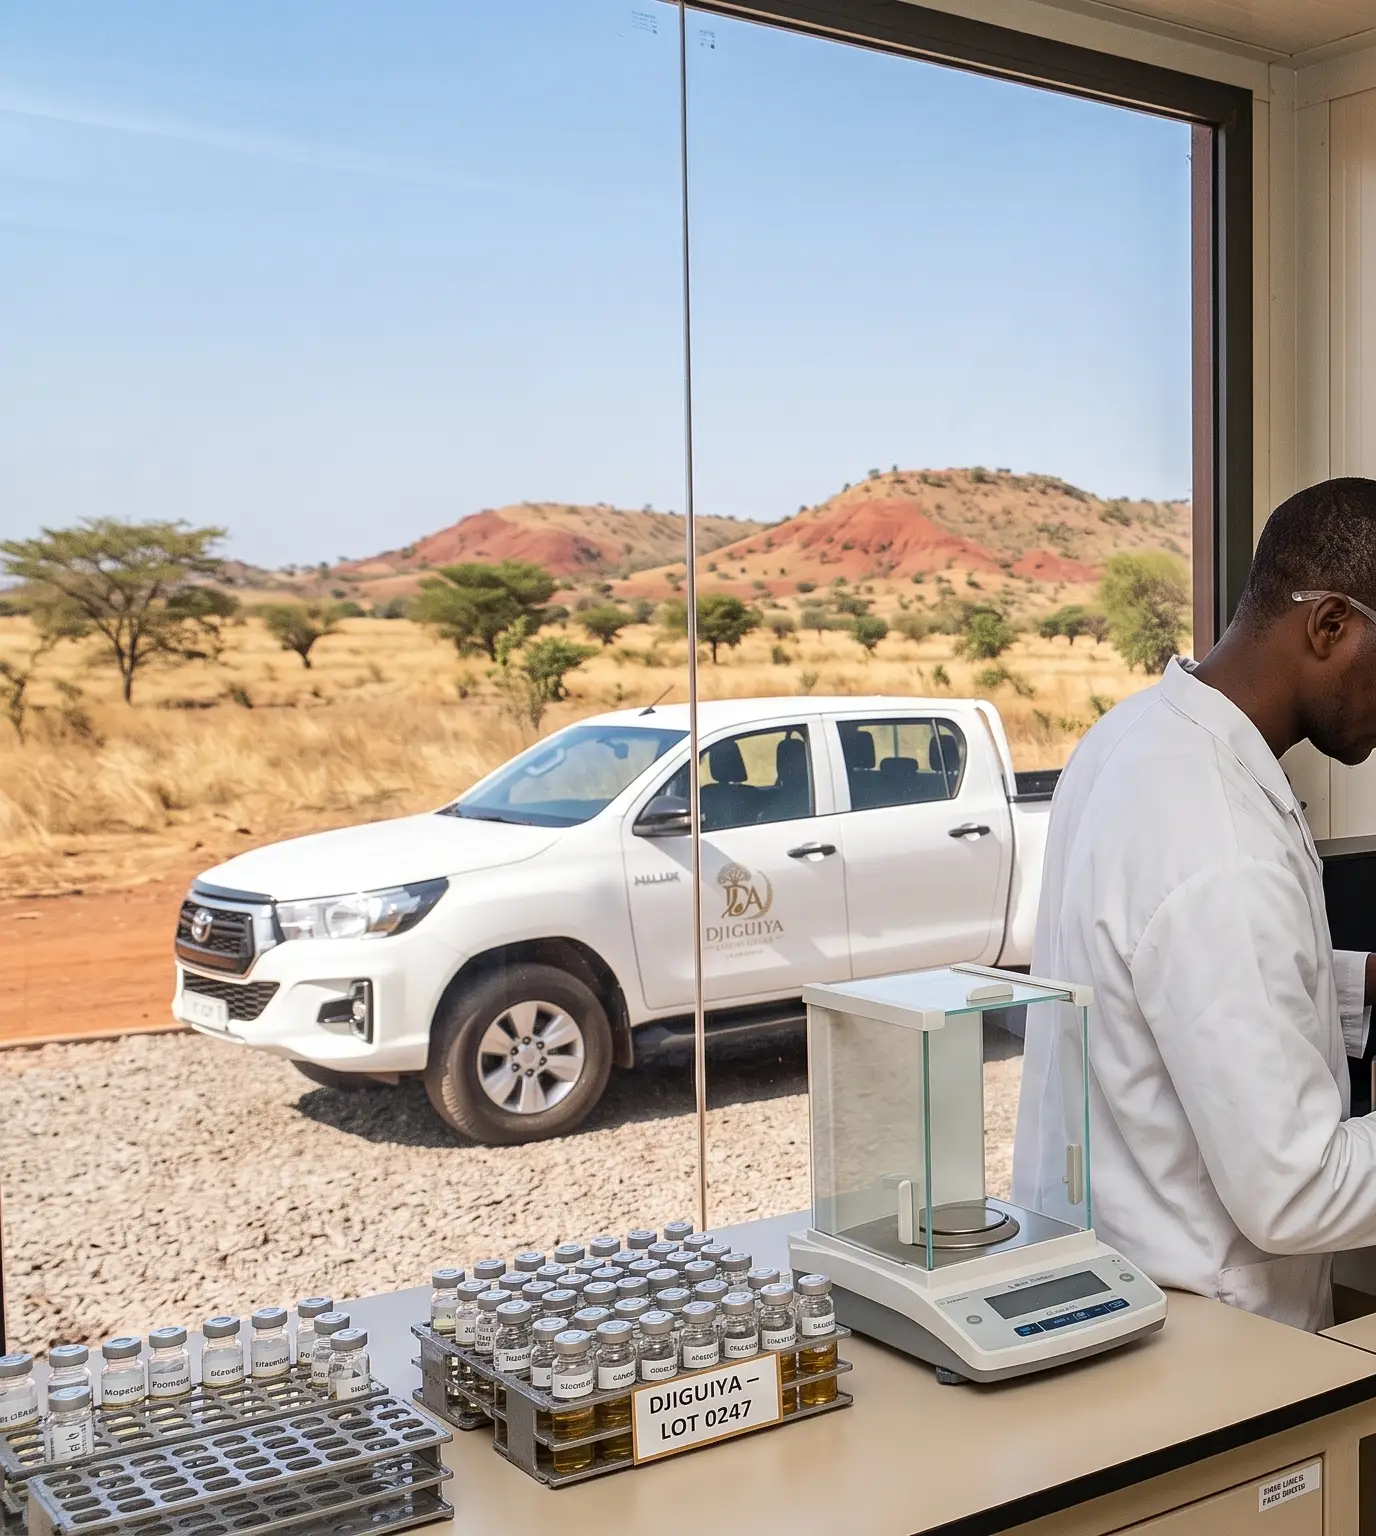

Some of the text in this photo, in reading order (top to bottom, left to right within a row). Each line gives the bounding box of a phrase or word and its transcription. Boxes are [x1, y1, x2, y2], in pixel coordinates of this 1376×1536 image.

[706, 920, 784, 942] DJIGUIYA
[649, 1375, 742, 1414] DJIGUIYA
[661, 1399, 752, 1440] LOT 0247
